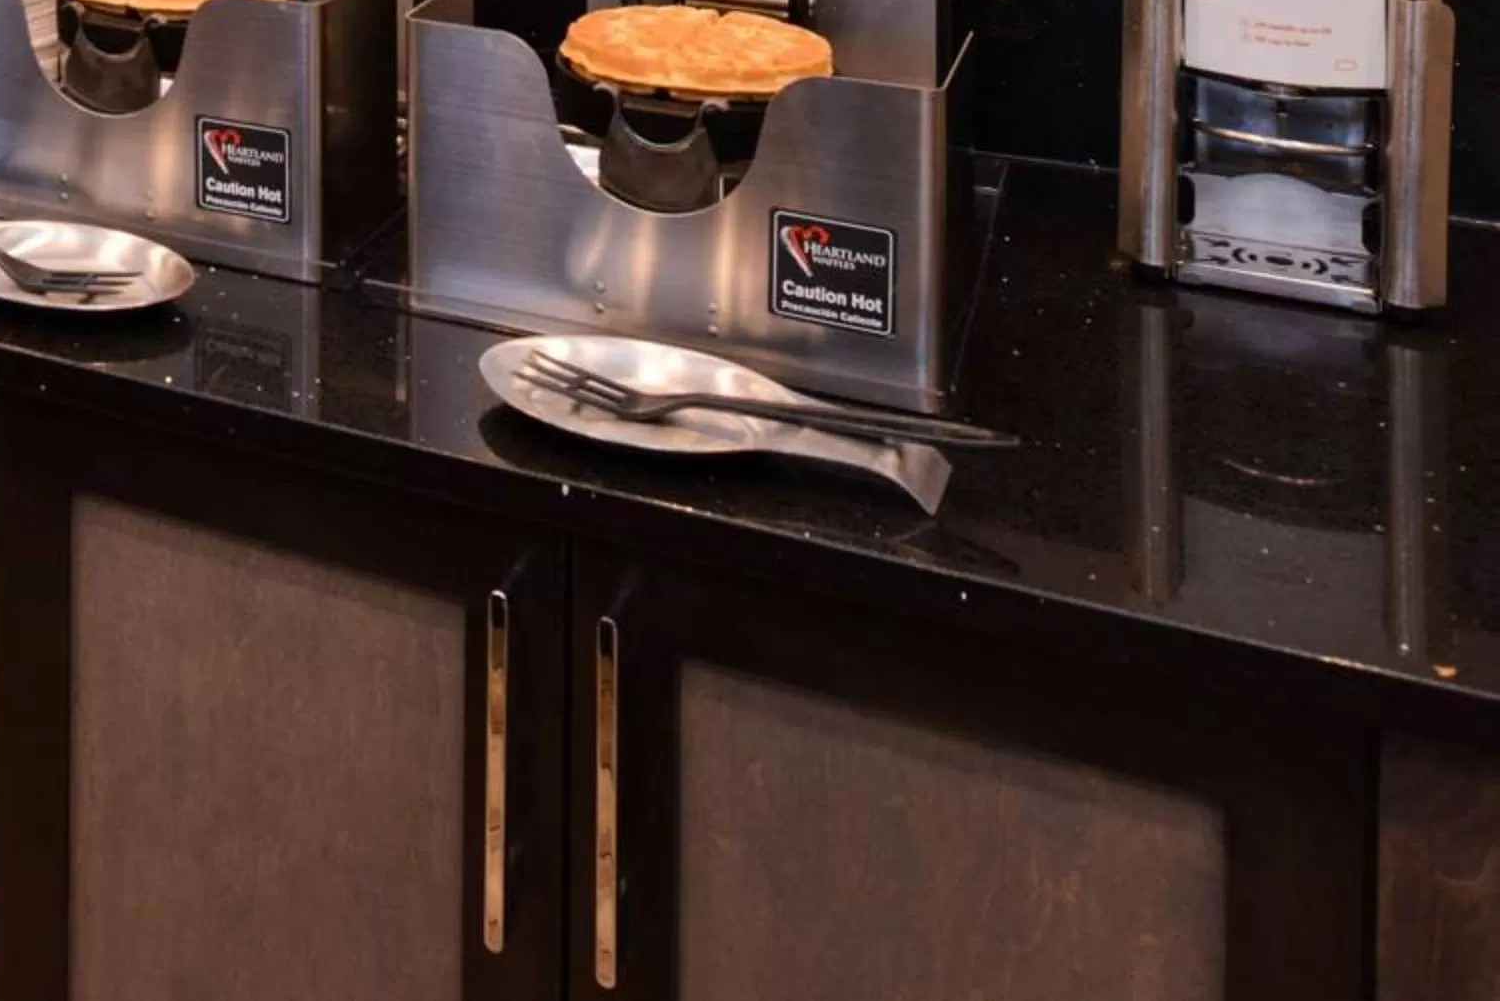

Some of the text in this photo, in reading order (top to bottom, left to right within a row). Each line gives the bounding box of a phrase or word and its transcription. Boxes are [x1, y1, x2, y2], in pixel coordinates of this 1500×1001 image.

[205, 177, 283, 203] Caution Hot
[782, 279, 884, 315] Caution Hot
